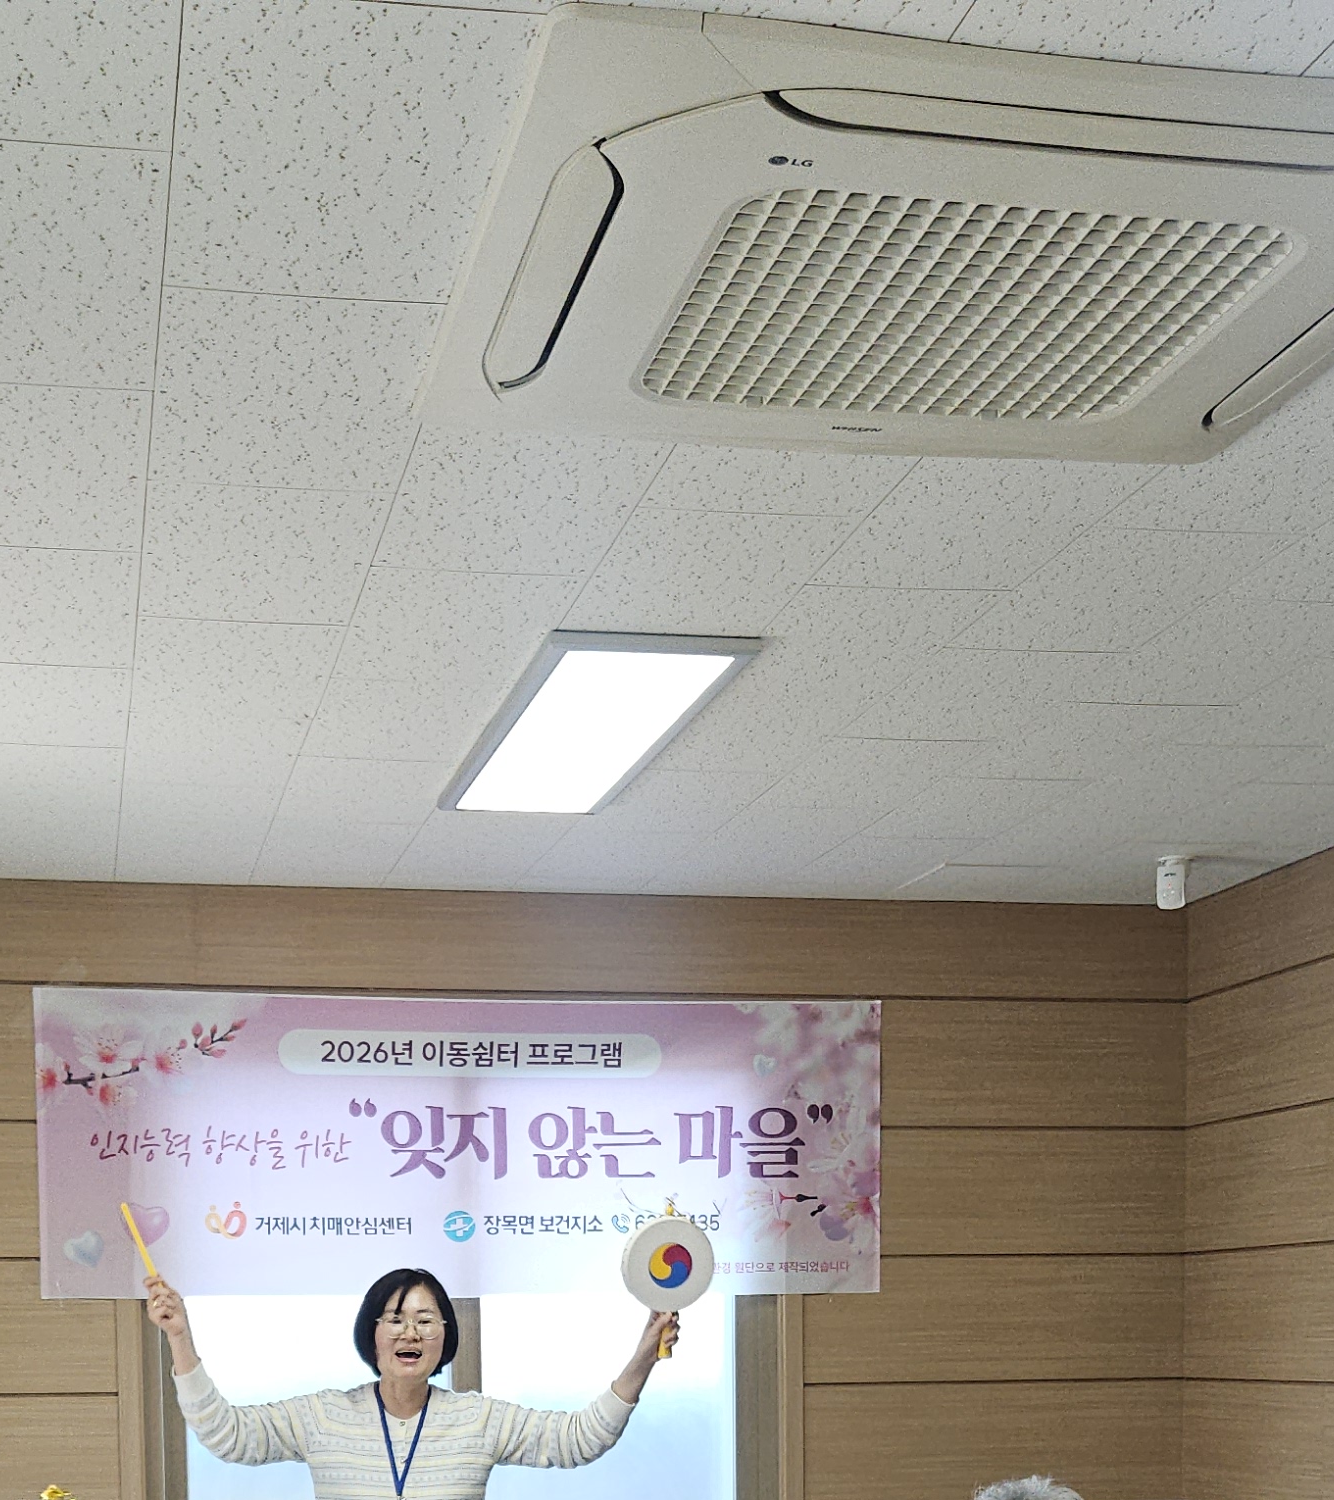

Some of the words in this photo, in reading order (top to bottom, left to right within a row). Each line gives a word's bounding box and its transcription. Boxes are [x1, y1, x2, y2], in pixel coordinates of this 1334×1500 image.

[791, 158, 814, 168] LG
[320, 1039, 414, 1066] 2026년
[422, 1040, 519, 1068] 이동쉼터
[526, 1041, 623, 1069] 프로그램
[90, 1127, 192, 1168] 인지능력
[202, 1125, 287, 1170] 향상을
[294, 1128, 352, 1169] 위한
[528, 1105, 662, 1180] 않는
[483, 1214, 536, 1236] 장목면
[538, 1214, 604, 1236] 보건지소
[734, 1261, 776, 1274] 원단으로
[779, 1260, 851, 1274] 제작되었습니다
